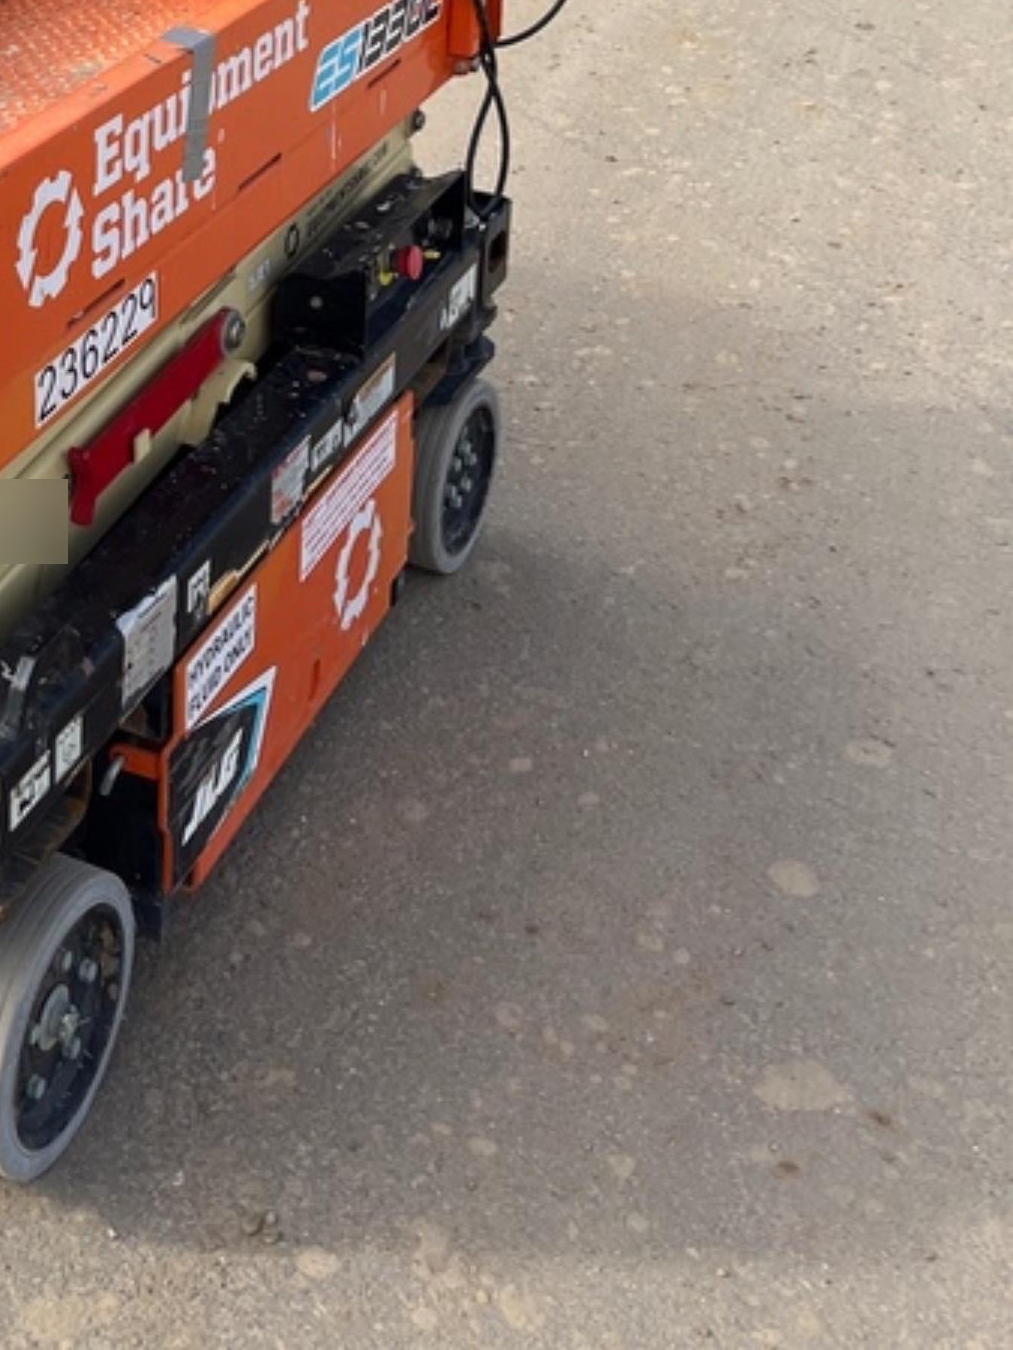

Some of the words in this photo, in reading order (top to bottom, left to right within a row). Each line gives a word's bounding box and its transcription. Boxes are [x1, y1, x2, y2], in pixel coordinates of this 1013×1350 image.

[91, 146, 216, 279] Share
[38, 278, 156, 421] 236229
[182, 729, 243, 846] JLG
